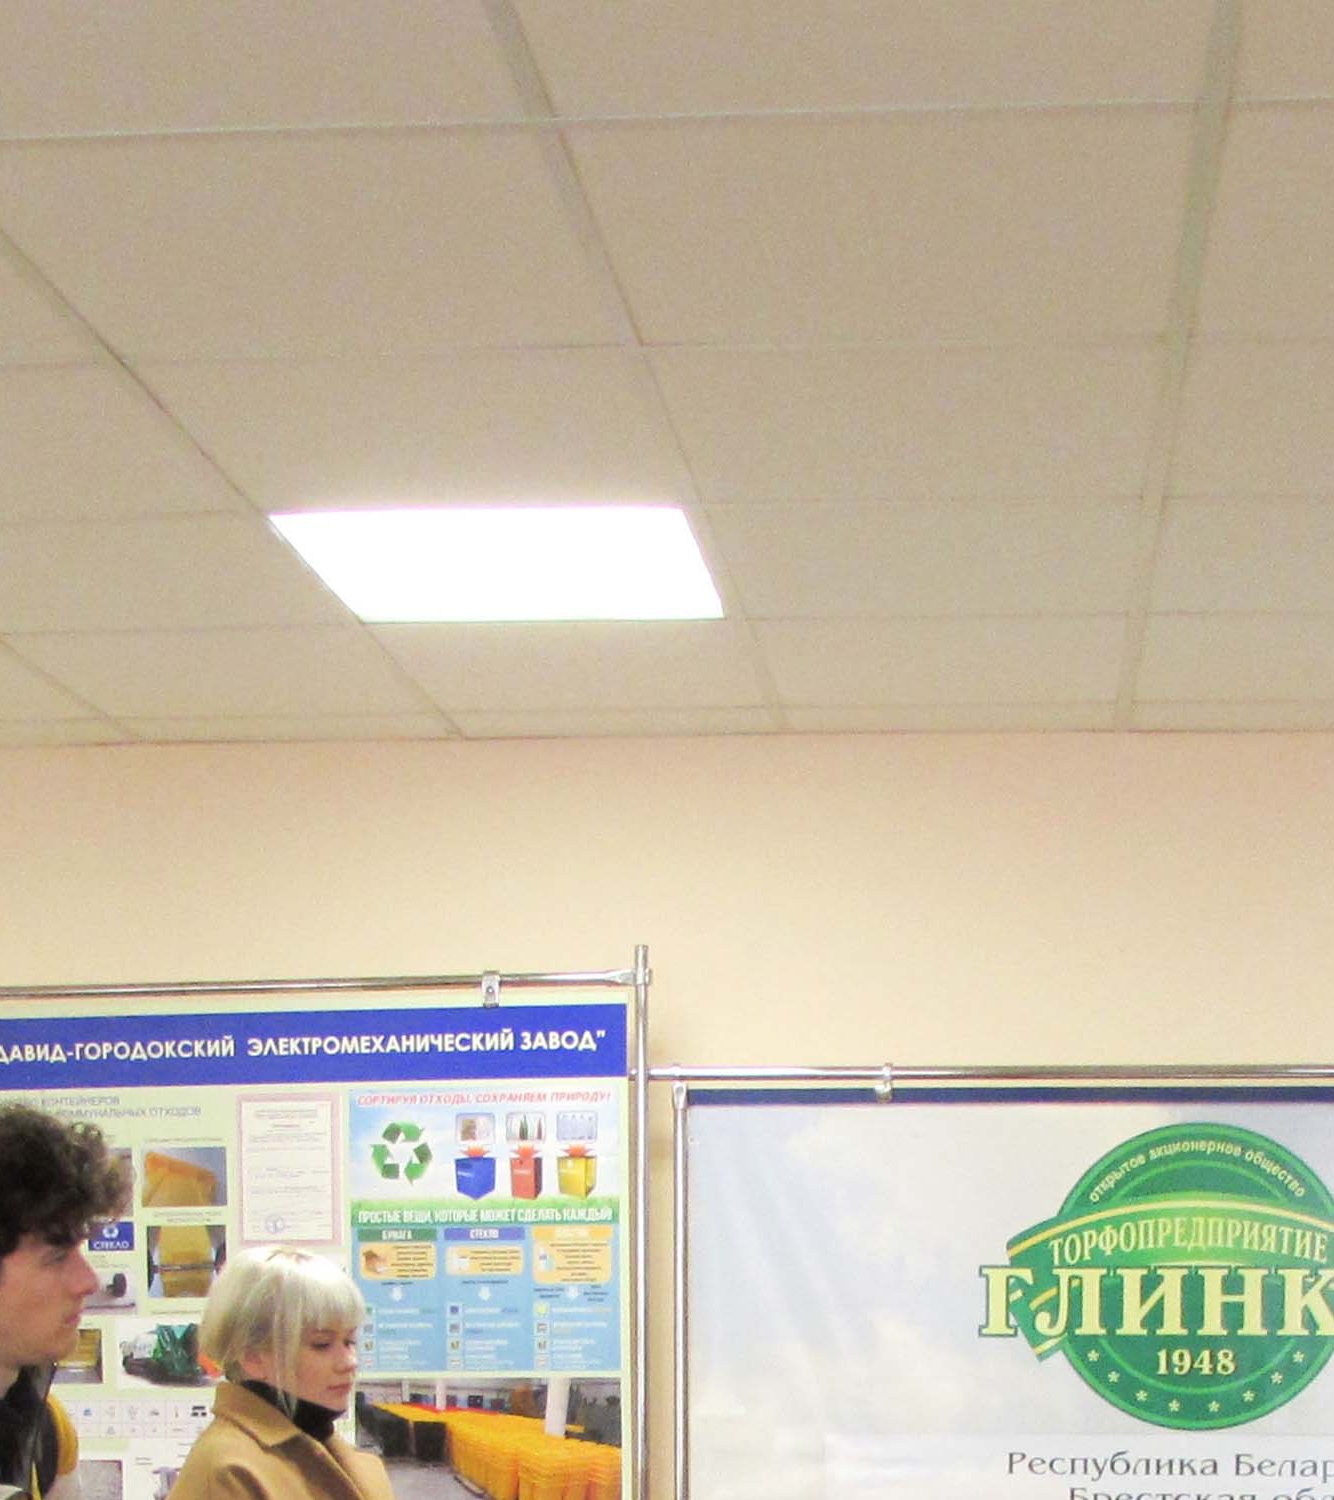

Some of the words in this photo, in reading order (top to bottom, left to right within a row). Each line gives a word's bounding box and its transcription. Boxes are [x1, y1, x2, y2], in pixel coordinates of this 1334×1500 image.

[247, 1028, 514, 1057] ЭЛЕКТРОМЕХАНИЧЕСКИЙ
[520, 1030, 606, 1053] ЗАВОД"
[550, 1091, 611, 1104] ПРИРОДУ!
[1090, 1153, 1146, 1202] открытое
[1149, 1139, 1242, 1160] акционерное
[1244, 1149, 1306, 1197] общество
[1049, 1215, 1328, 1265] ТОРФОПРЕДПРИЯТИЕ
[1156, 1348, 1237, 1376] 1948
[1007, 1450, 1218, 1482] Республика
